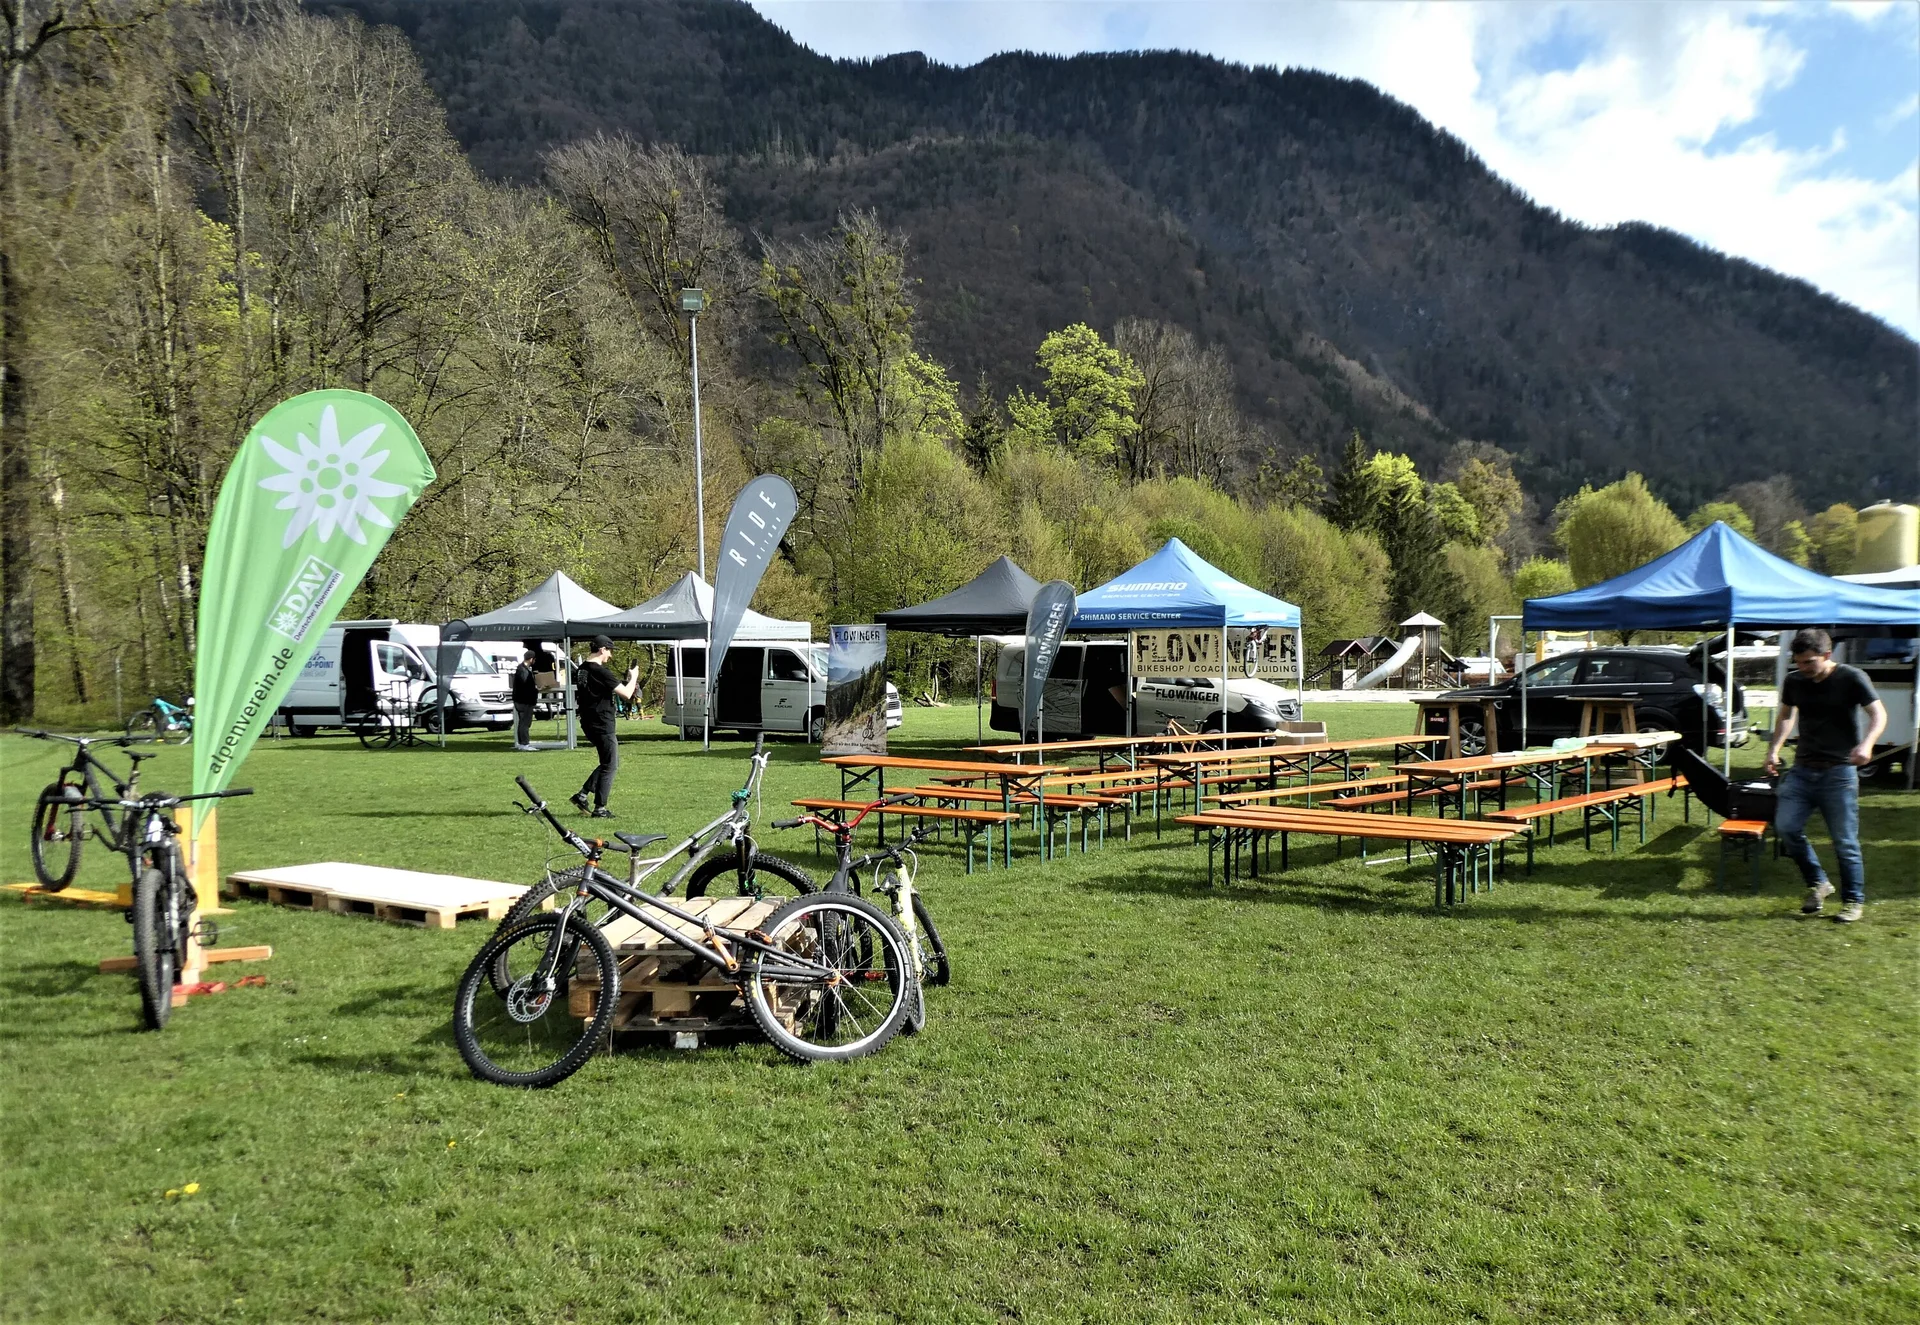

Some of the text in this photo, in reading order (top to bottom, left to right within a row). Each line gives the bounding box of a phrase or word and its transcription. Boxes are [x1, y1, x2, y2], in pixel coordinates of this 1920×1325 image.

[729, 491, 777, 567] RIDE
[284, 562, 326, 614] DAV
[294, 572, 341, 641] Deutscher Alpenverein
[1106, 582, 1188, 592] SHIMANO
[835, 630, 880, 641] FLOWINGER
[1080, 612, 1116, 621] SHIMANO
[1118, 612, 1150, 620] SERVICE
[1032, 602, 1066, 681] FLOWINGER
[1136, 633, 1298, 663] FLOWINER
[210, 647, 294, 774] alpenverein.de
[1155, 688, 1220, 702] FLOWINGER
